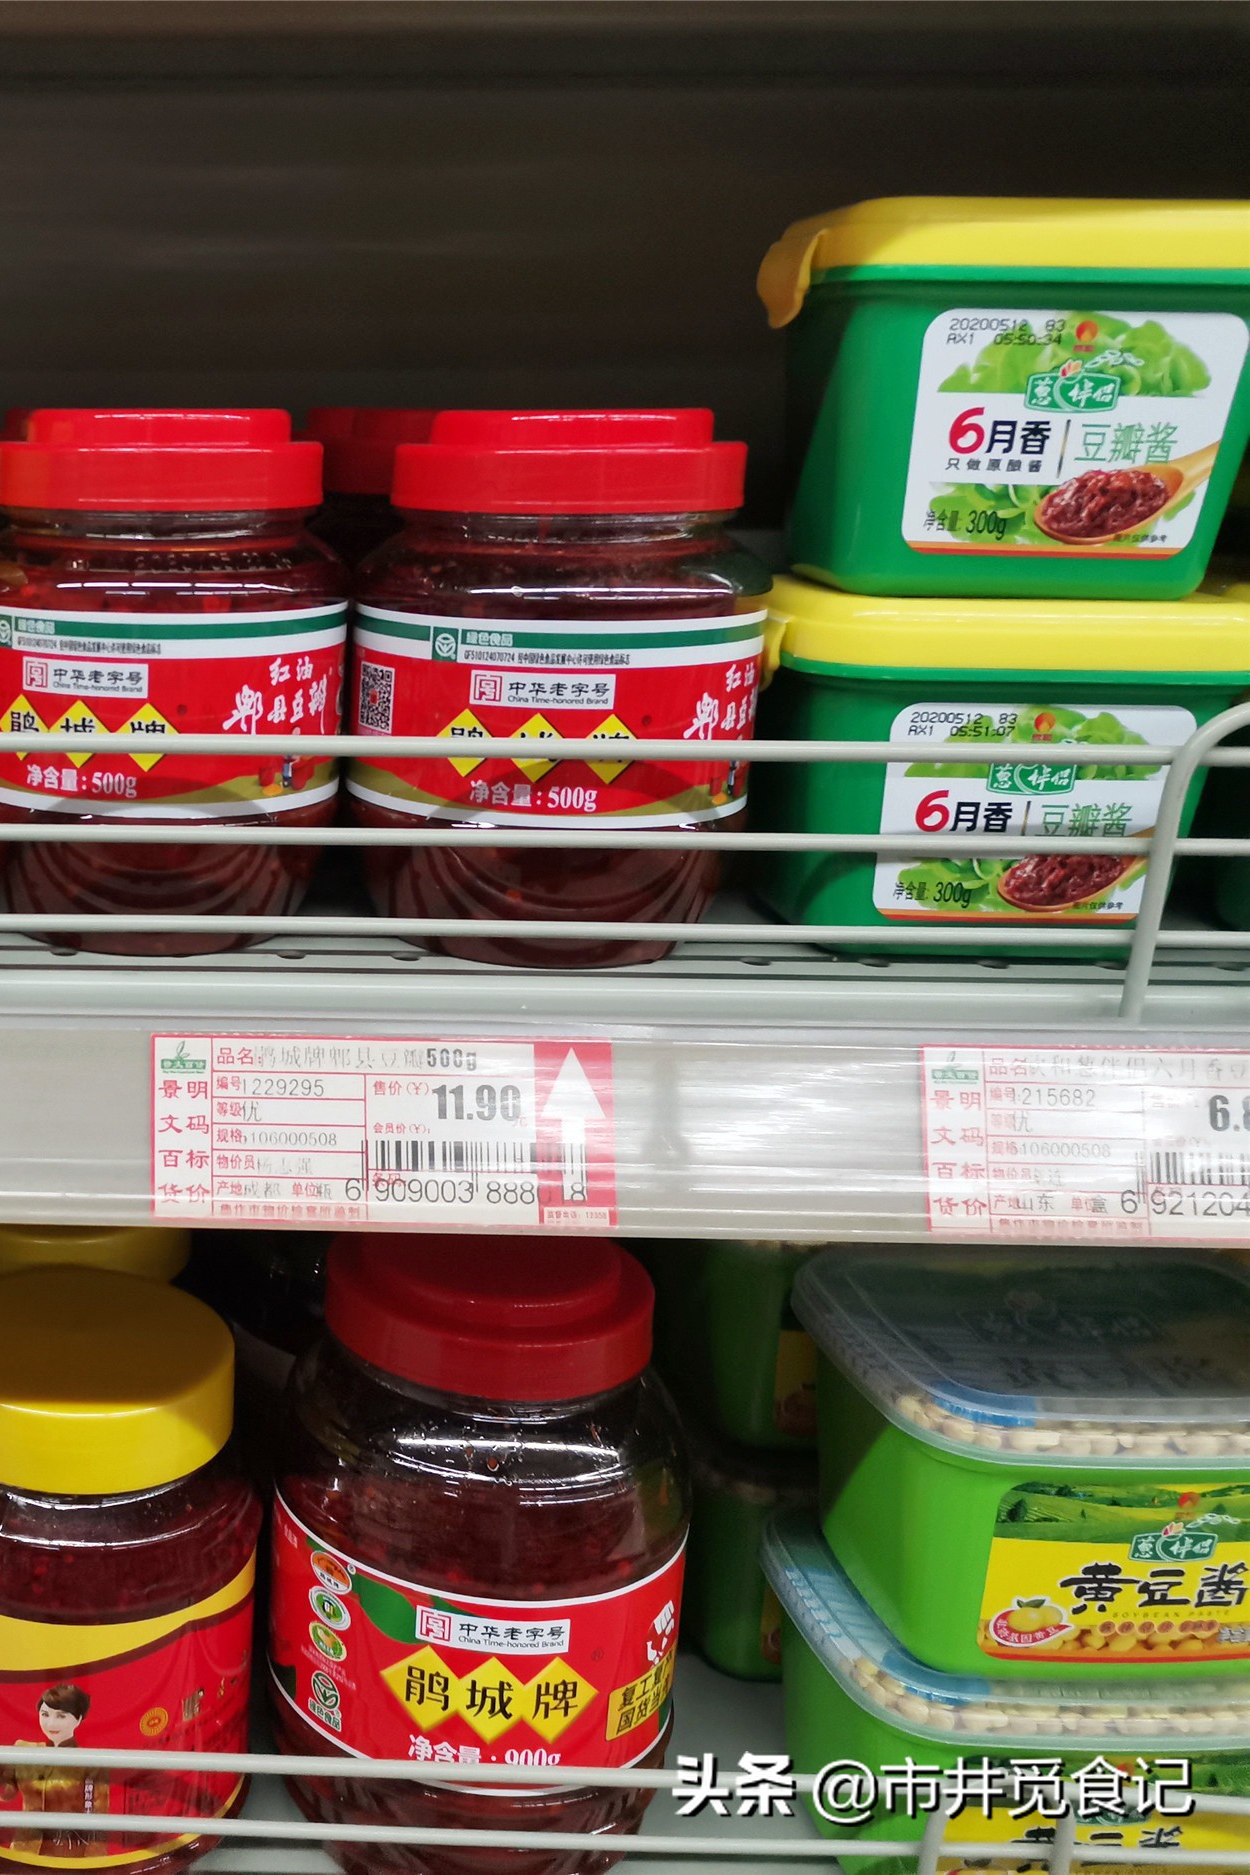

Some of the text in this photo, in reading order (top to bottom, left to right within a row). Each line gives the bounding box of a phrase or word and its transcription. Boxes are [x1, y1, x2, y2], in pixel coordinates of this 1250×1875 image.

[949, 317, 1029, 332] 20200512
[1031, 377, 1116, 406] 葱伴侣
[949, 407, 1178, 464] 6月香 豆瓣酱
[53, 667, 143, 686] 中华老字号
[269, 656, 313, 686] 红油
[726, 662, 755, 692] 红油
[507, 695, 608, 705] China Time-honored Brand
[508, 681, 610, 698] 中华老字号
[910, 712, 1018, 725] 20200512 83
[950, 725, 1015, 737] 05:51:07
[993, 765, 1072, 792] 葱伴侣
[470, 779, 597, 812] 净含量:500g
[915, 789, 1133, 837] 6月香 豆瓣酱
[243, 1078, 325, 1097] 1229295
[242, 1101, 262, 1122] 优
[432, 1084, 523, 1121] 11.90
[345, 1178, 361, 1201] 6
[375, 1178, 473, 1204] 909003
[1121, 1189, 1250, 1216] 6 921204
[1134, 1536, 1213, 1559] 葱伴侣
[1059, 1562, 1250, 1614] 黄豆酱
[458, 1622, 566, 1641] 中华老字号
[458, 1635, 565, 1649] China Time-honored Brand
[404, 1665, 579, 1720] 鹃城牌
